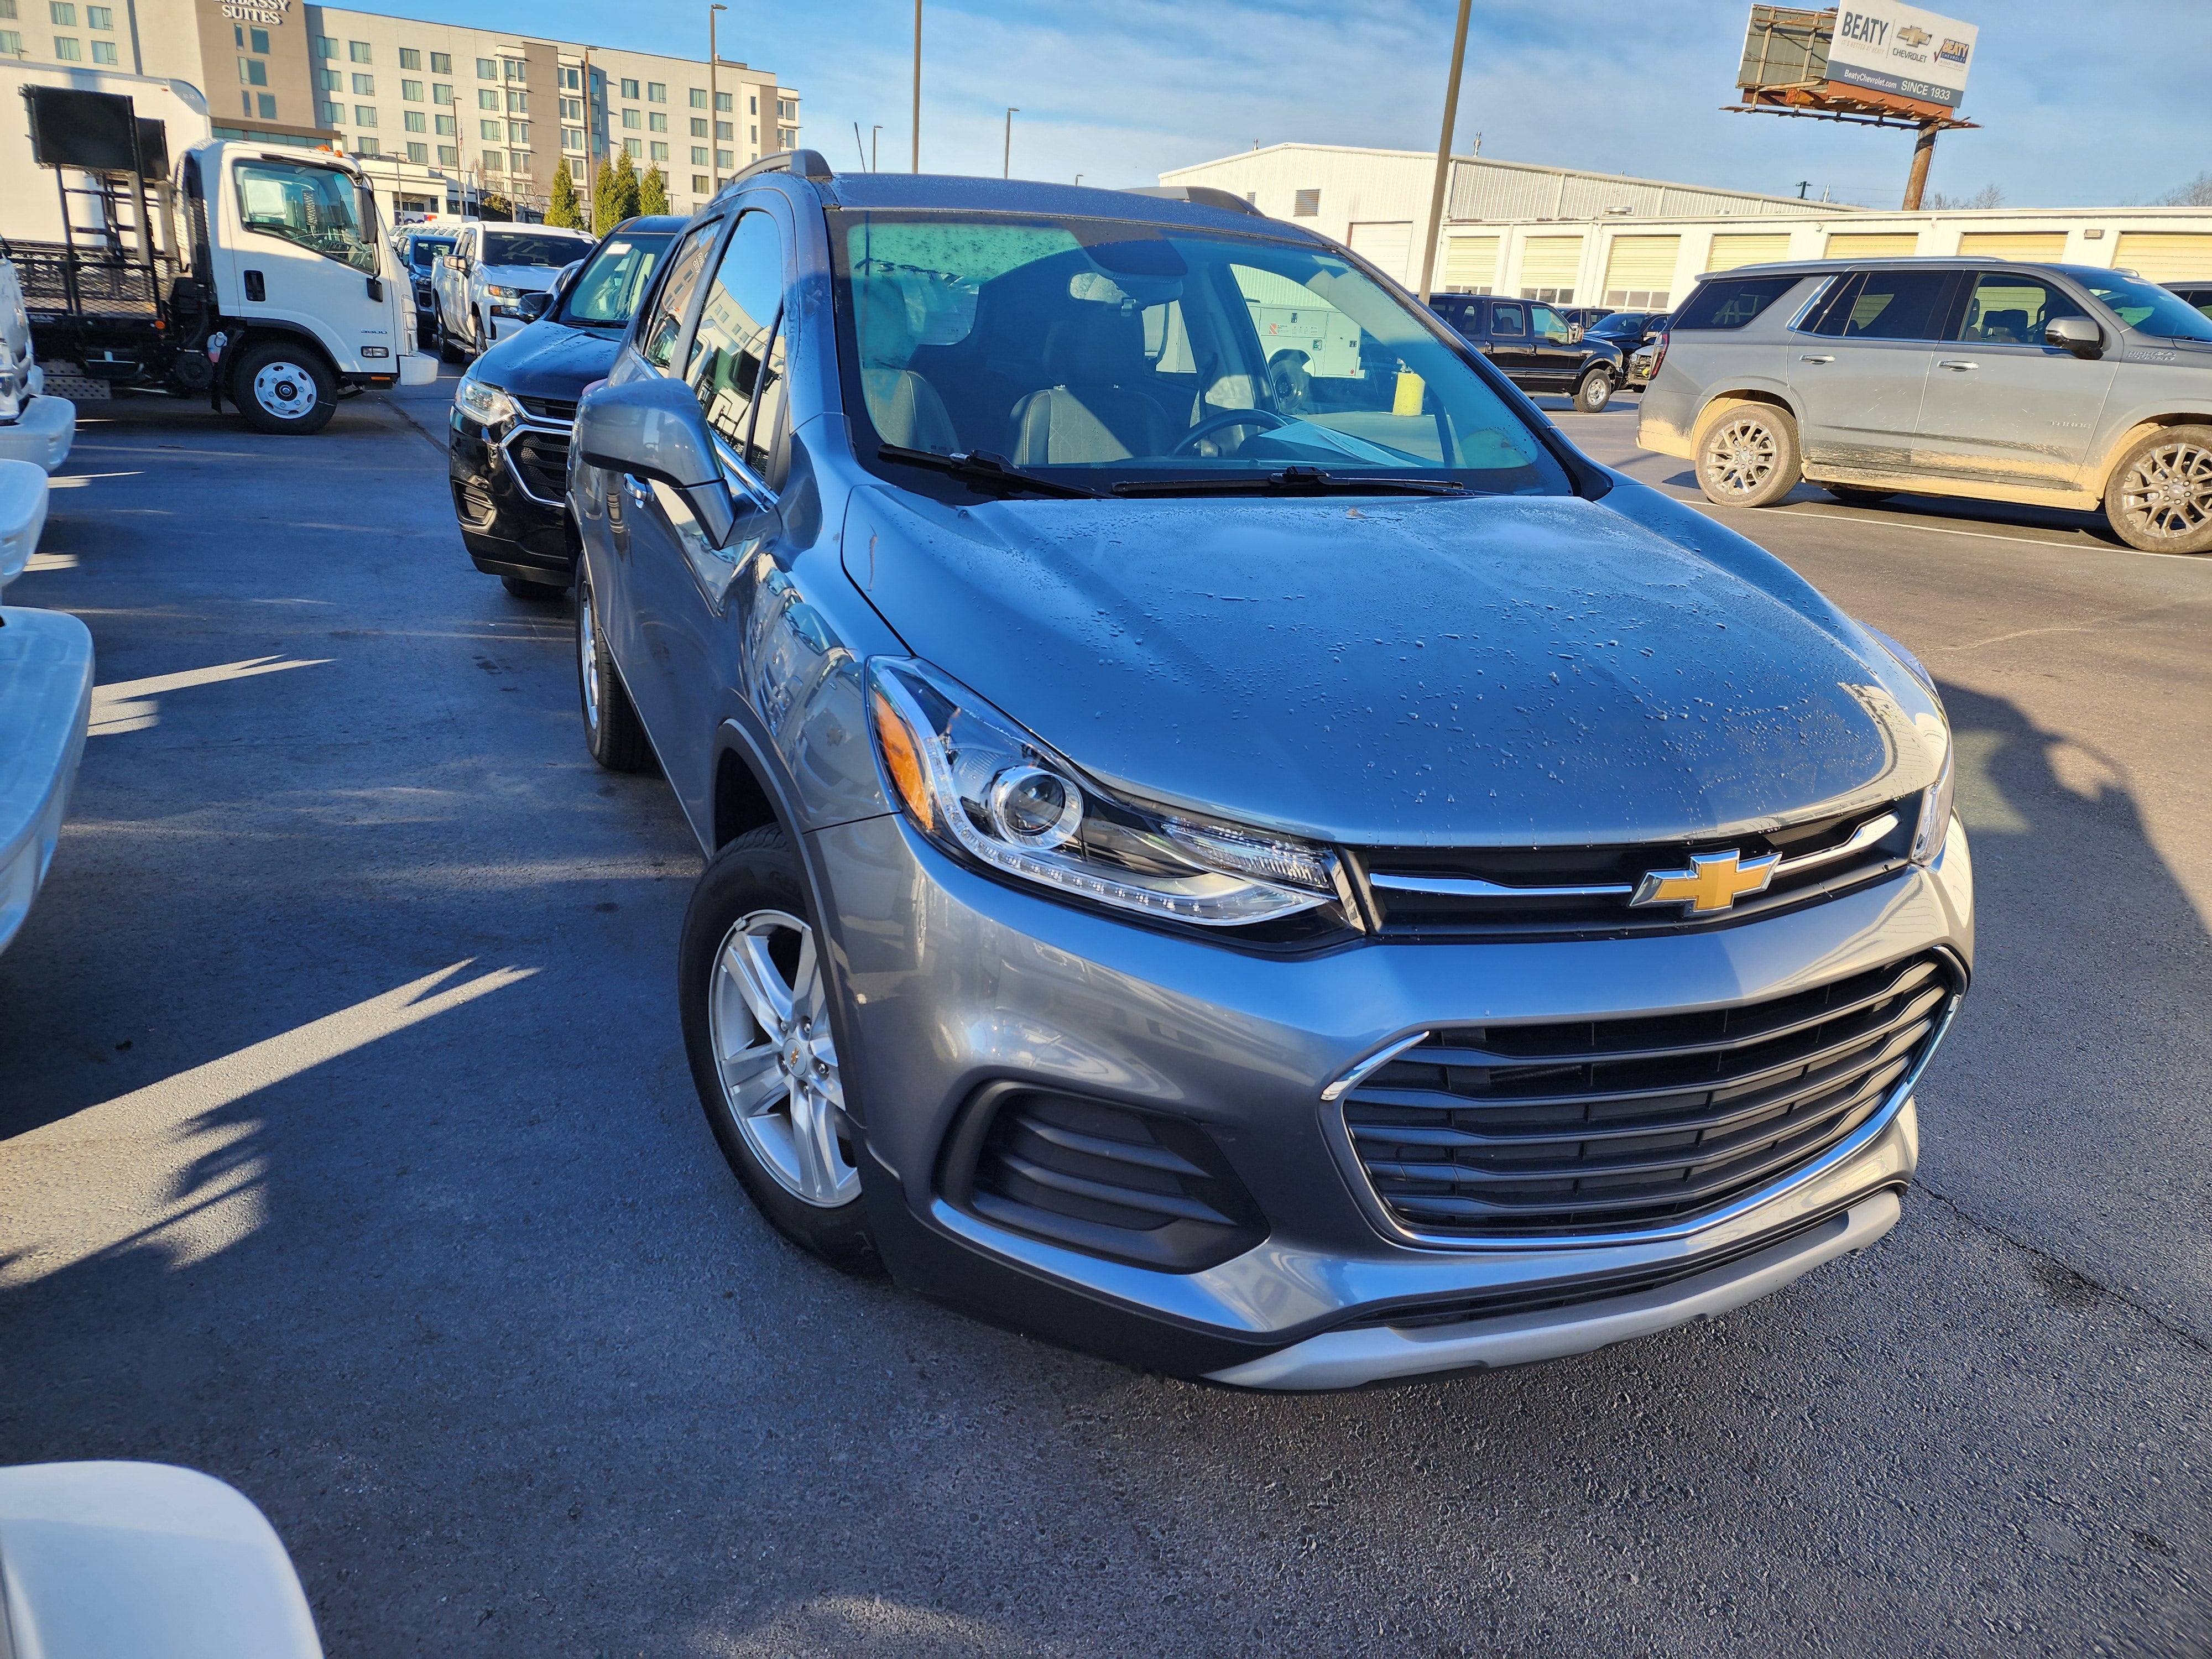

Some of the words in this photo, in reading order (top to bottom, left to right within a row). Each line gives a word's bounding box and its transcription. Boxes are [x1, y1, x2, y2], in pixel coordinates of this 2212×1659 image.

[222, 4, 281, 25] SUITES
[1841, 11, 1888, 45] BEATY
[1892, 48, 1927, 63] CHEVROLET
[1941, 53, 1965, 62] CHEVROLET
[1942, 40, 1969, 58] BEATY
[1844, 69, 1897, 88] BeatyChevrolet.com
[1901, 80, 1929, 95] SINCE
[1931, 87, 1950, 100] 1933
